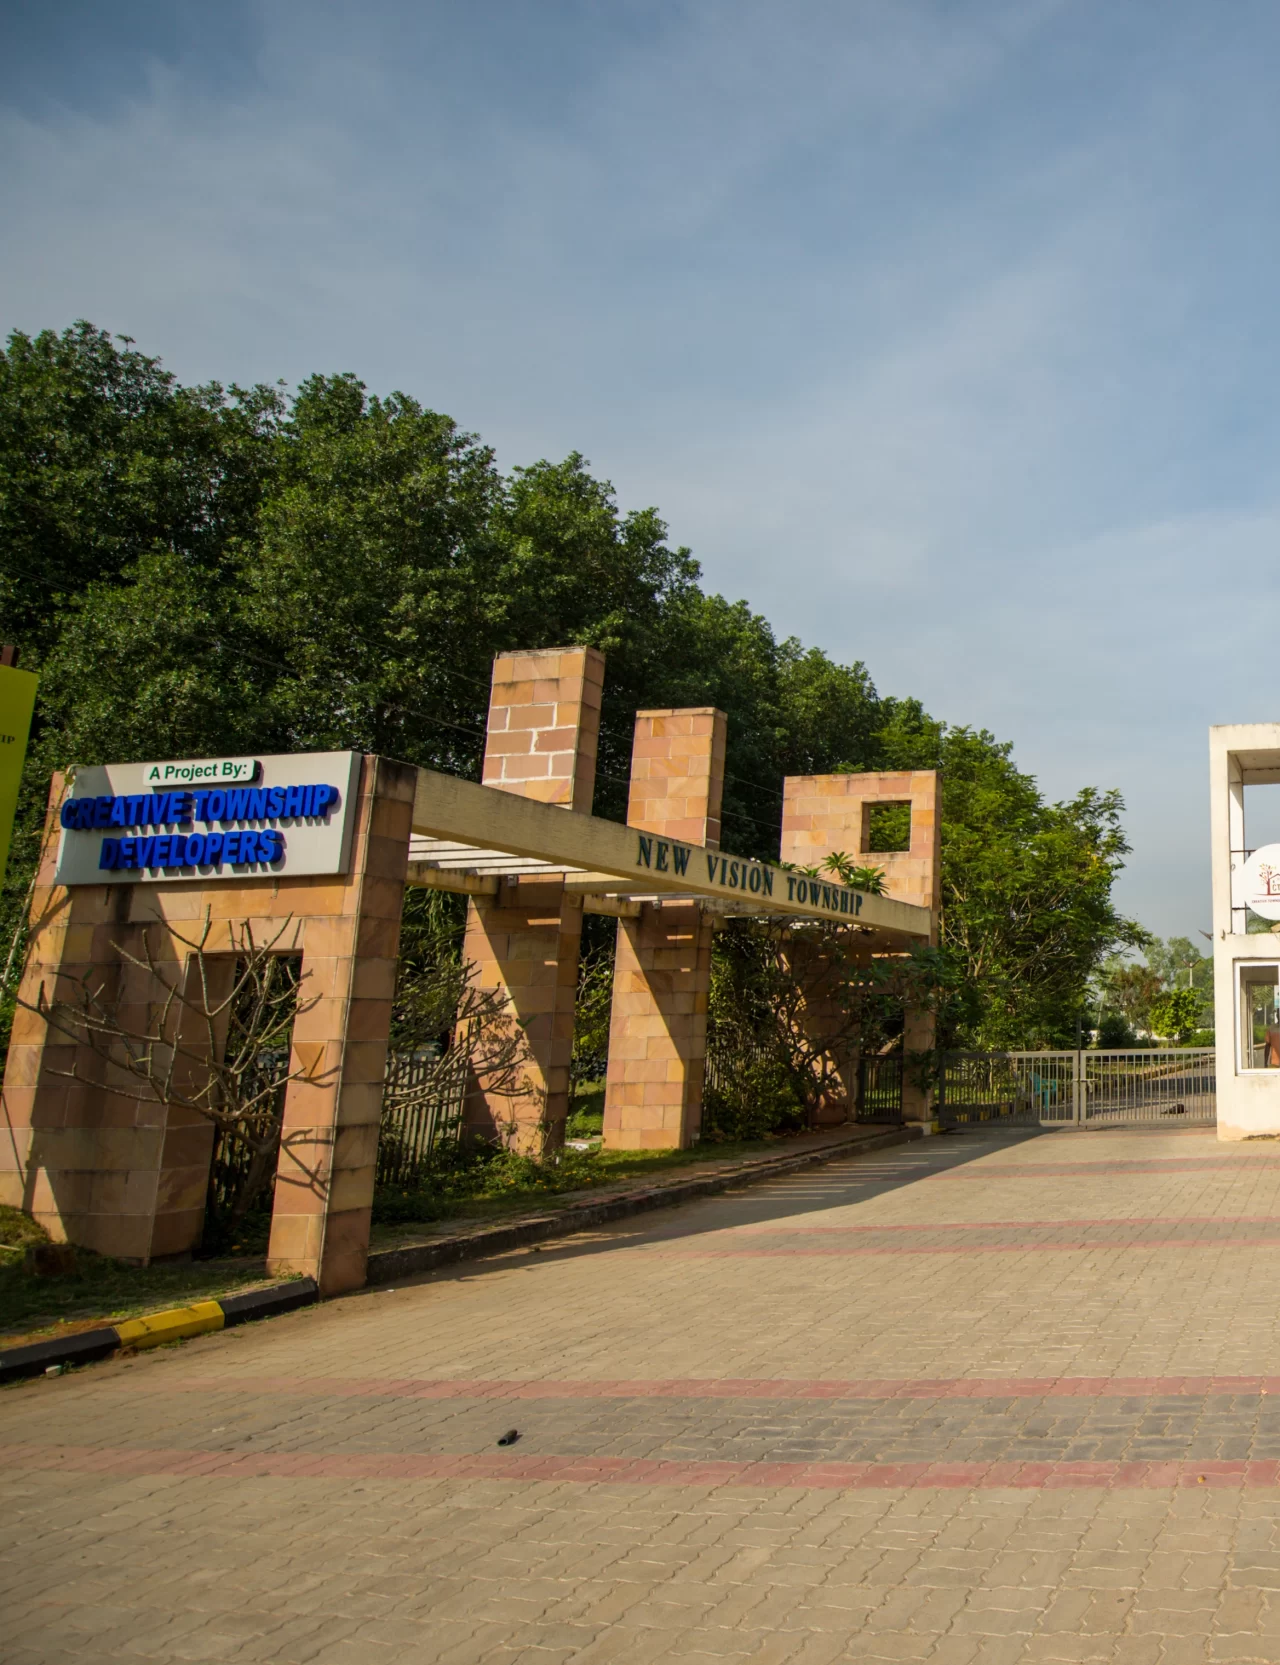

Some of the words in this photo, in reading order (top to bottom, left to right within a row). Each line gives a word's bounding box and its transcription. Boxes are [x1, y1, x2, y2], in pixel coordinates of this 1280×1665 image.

[0, 734, 16, 745] IP
[149, 766, 161, 781] A
[164, 763, 218, 782] Project
[222, 761, 248, 779] By:
[61, 791, 192, 830] CREATIVE
[193, 784, 338, 822] TOWNSHIP
[99, 829, 284, 870] DEVELOPERS
[636, 835, 691, 877] NEW
[707, 854, 775, 897] VISION
[787, 876, 863, 917] TOWNSHIP
